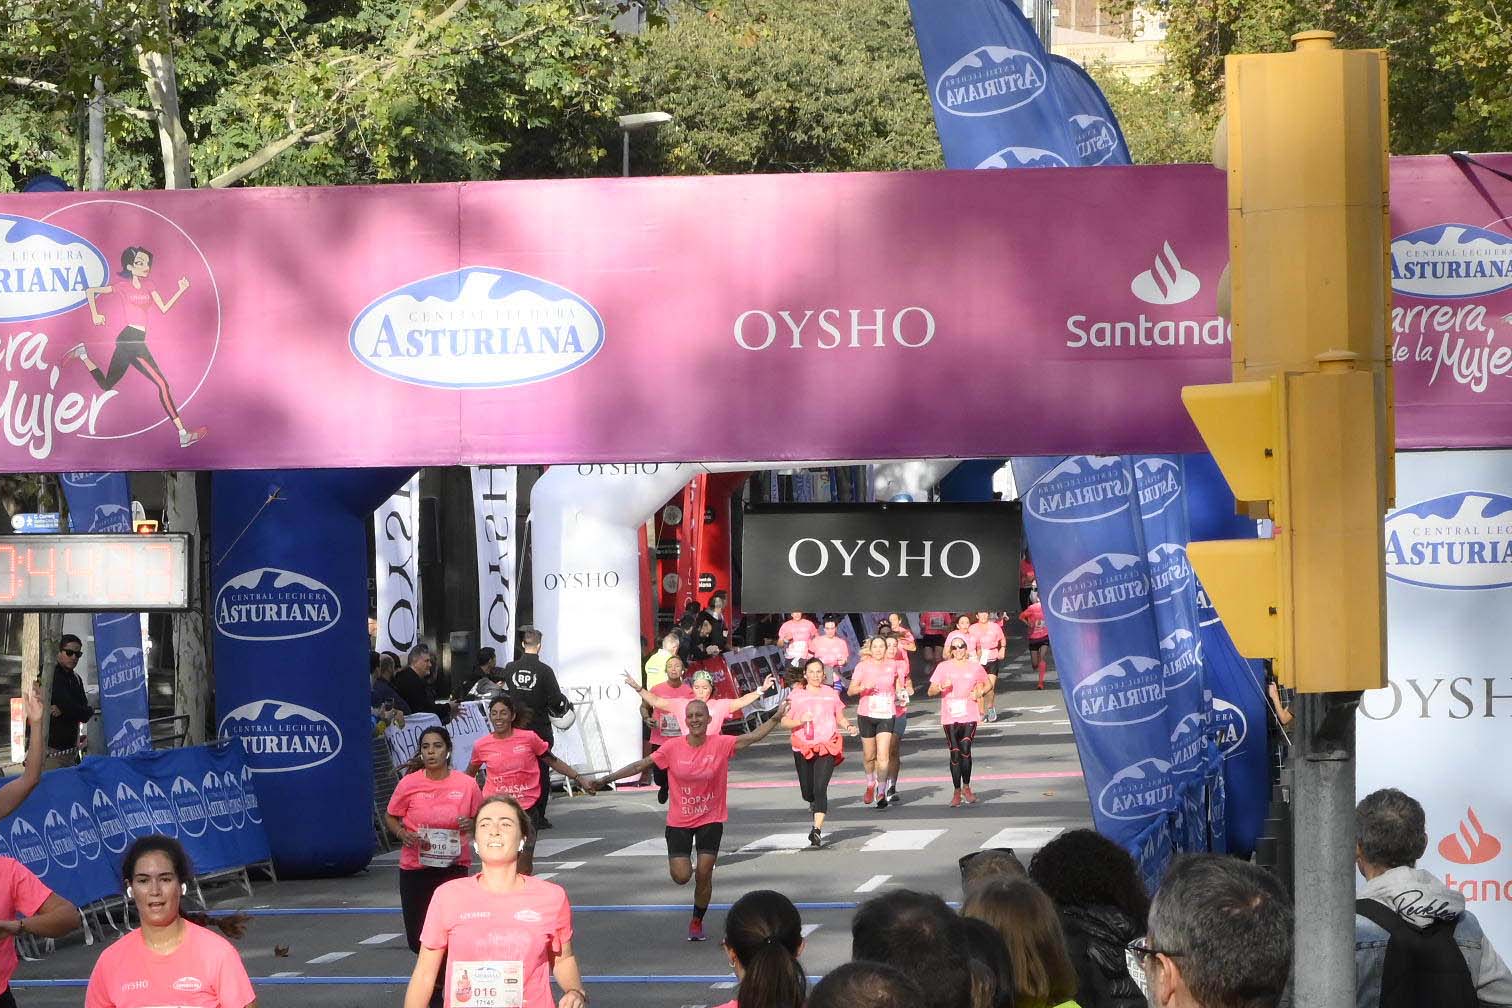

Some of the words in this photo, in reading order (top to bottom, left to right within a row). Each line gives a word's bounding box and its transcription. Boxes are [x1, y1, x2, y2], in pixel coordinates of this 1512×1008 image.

[1406, 248, 1458, 258] CENTRAL
[733, 306, 936, 351] OYSHO
[1391, 304, 1486, 333] arrera
[369, 313, 585, 359] ASTURIANA
[1415, 333, 1433, 361] la
[1428, 331, 1512, 393] Muje
[1413, 526, 1481, 536] CENTRAL
[386, 481, 413, 653] OYS
[484, 466, 510, 645] OYSH
[788, 537, 982, 579] OYSHO
[544, 570, 620, 592] OYSHO
[231, 593, 275, 602] CENTRAL
[278, 592, 327, 601] LECHERA
[219, 599, 332, 625] ASTURIANA
[518, 674, 531, 684] BP
[1358, 676, 1512, 721] OYSH
[219, 728, 332, 755] ATURIANA
[278, 724, 328, 733] LECHERA
[474, 987, 497, 997] 016
